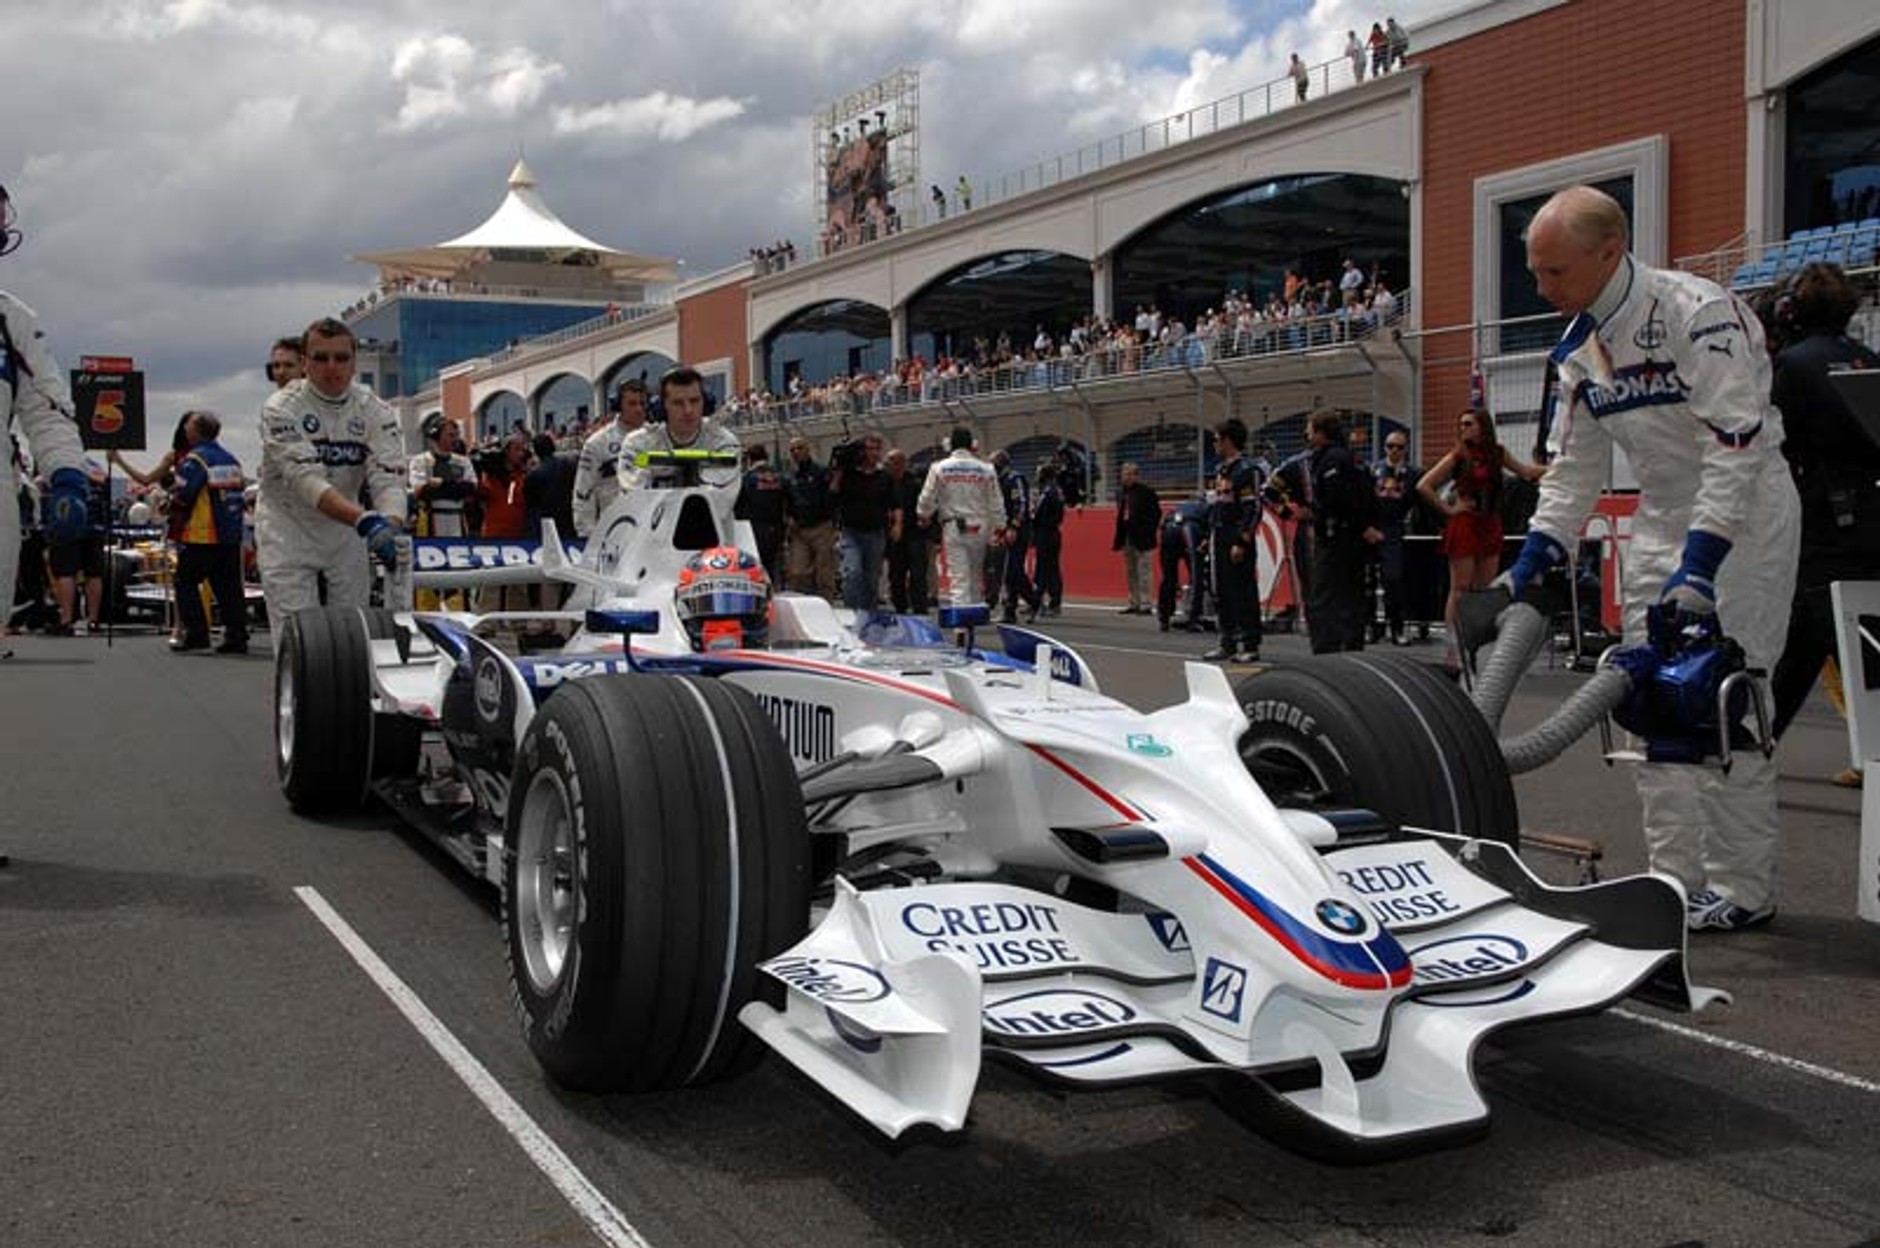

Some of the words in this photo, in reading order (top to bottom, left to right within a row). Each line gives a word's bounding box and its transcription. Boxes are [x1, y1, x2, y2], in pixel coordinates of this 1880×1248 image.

[91, 390, 126, 434] 5
[1244, 700, 1316, 735] ESTONE
[1337, 859, 1434, 895] REDIT
[902, 902, 1059, 938] CREDIT
[1370, 890, 1461, 924] UISSE
[771, 957, 867, 999] intel
[982, 1001, 1120, 1034] intel
